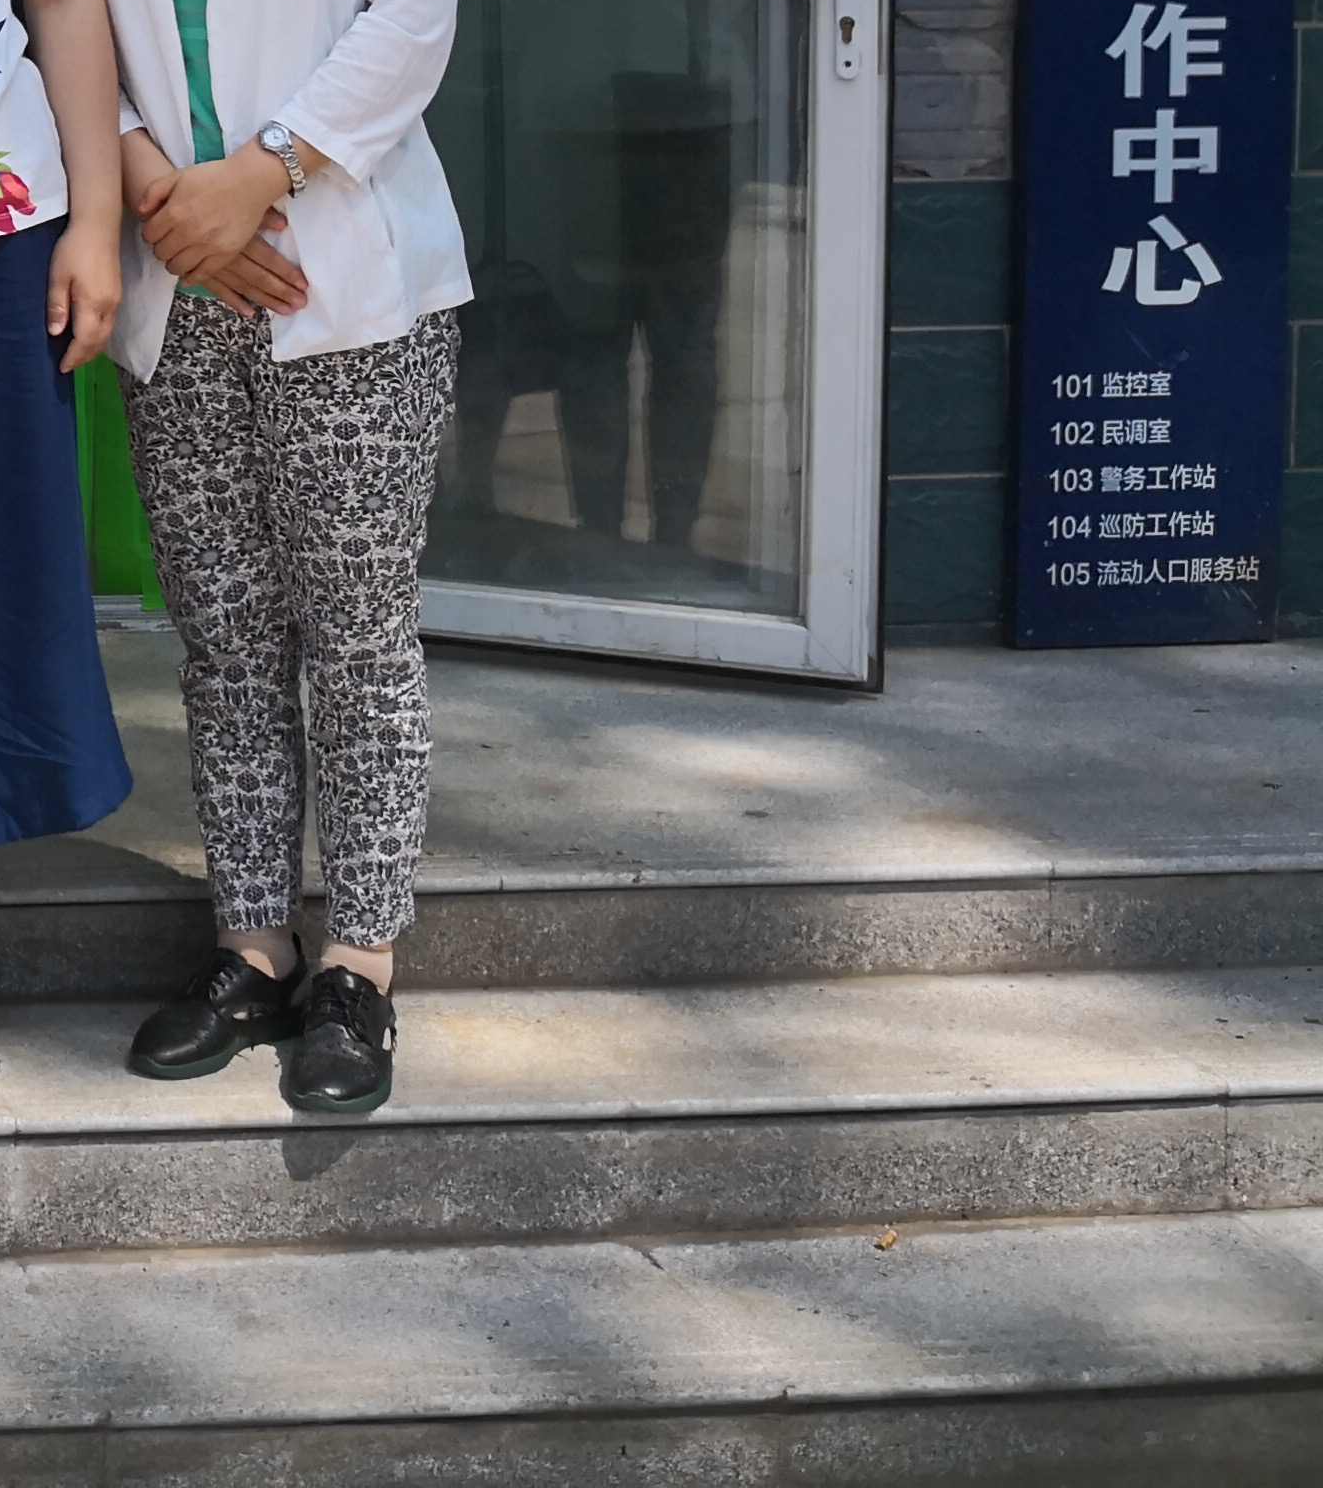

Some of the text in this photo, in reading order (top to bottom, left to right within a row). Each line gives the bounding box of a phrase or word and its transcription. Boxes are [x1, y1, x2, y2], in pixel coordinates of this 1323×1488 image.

[1052, 371, 1172, 398] 101 监控室
[1050, 418, 1171, 446] 102 民调室
[1049, 463, 1217, 493] 103 警务工作站
[1047, 510, 1215, 539] 104 巡防工作站
[1046, 556, 1260, 587] 105 流动人口服务站
